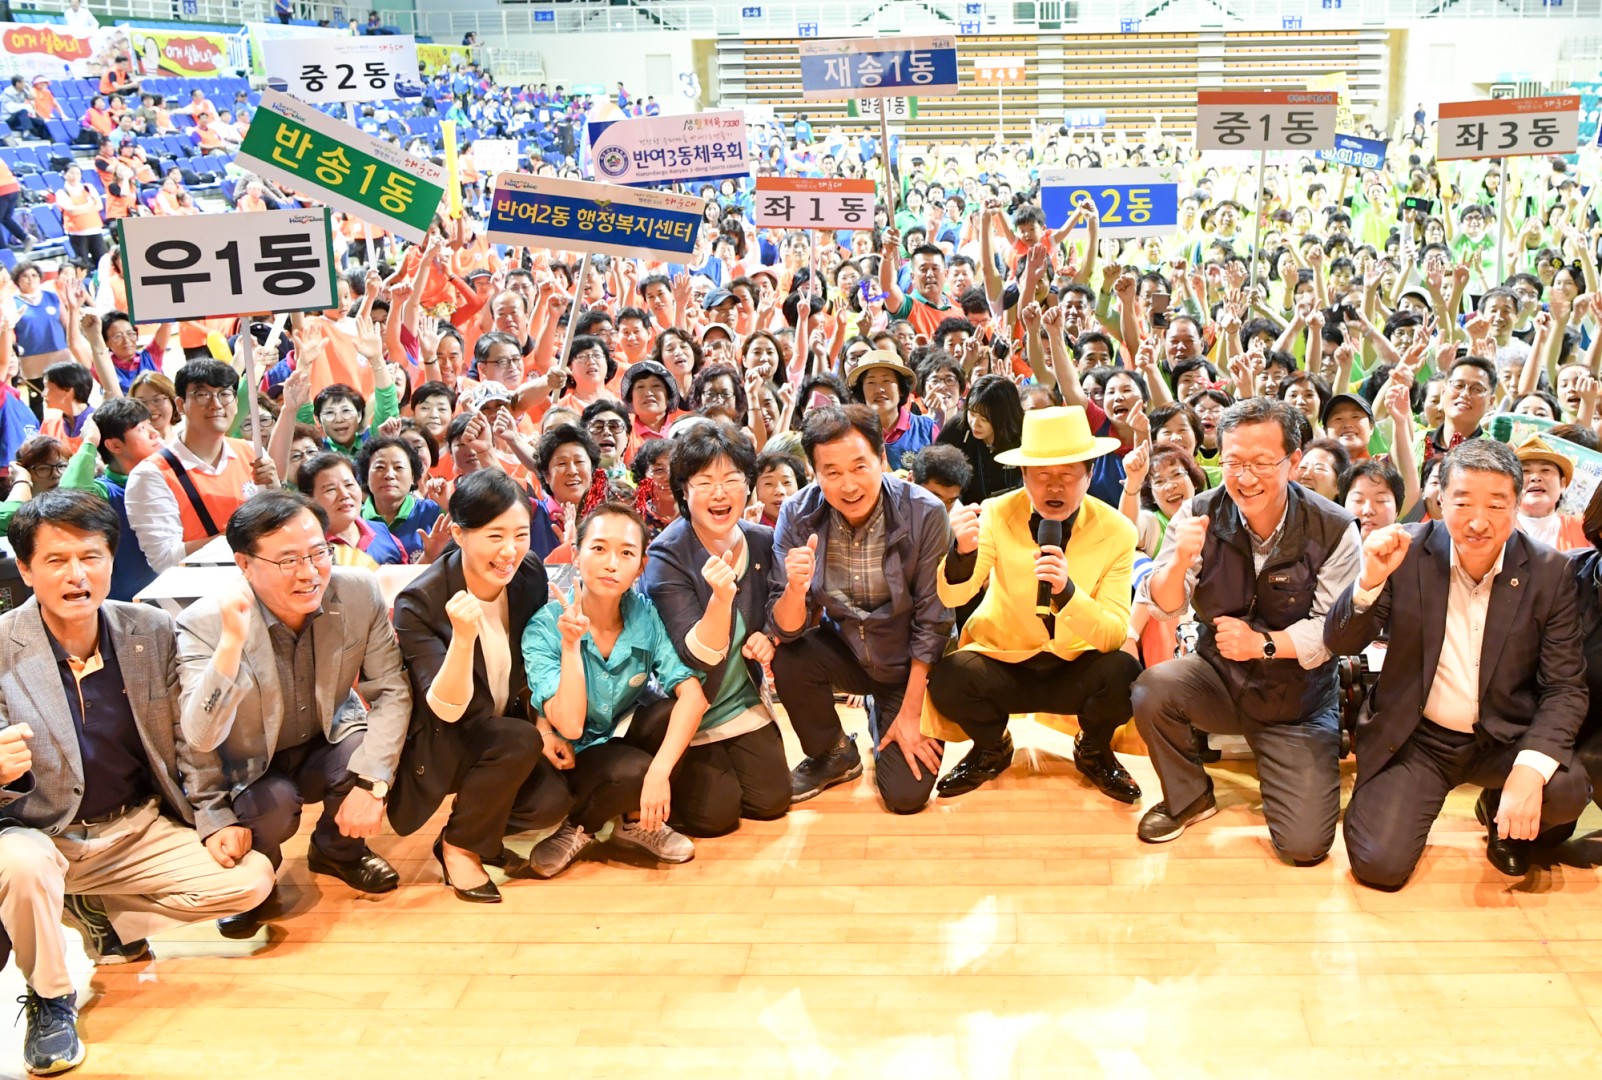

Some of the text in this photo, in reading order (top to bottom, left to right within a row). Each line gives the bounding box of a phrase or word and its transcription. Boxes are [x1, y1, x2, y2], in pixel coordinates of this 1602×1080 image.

[824, 53, 935, 87] 재송1동
[723, 119, 740, 128] 7330
[1213, 112, 1319, 145] 중1동
[272, 123, 417, 213] 반송1동
[633, 142, 744, 169] 반여3동체육회
[497, 199, 693, 242] 반여2동 행정복지센터
[141, 233, 320, 304] 우1동
